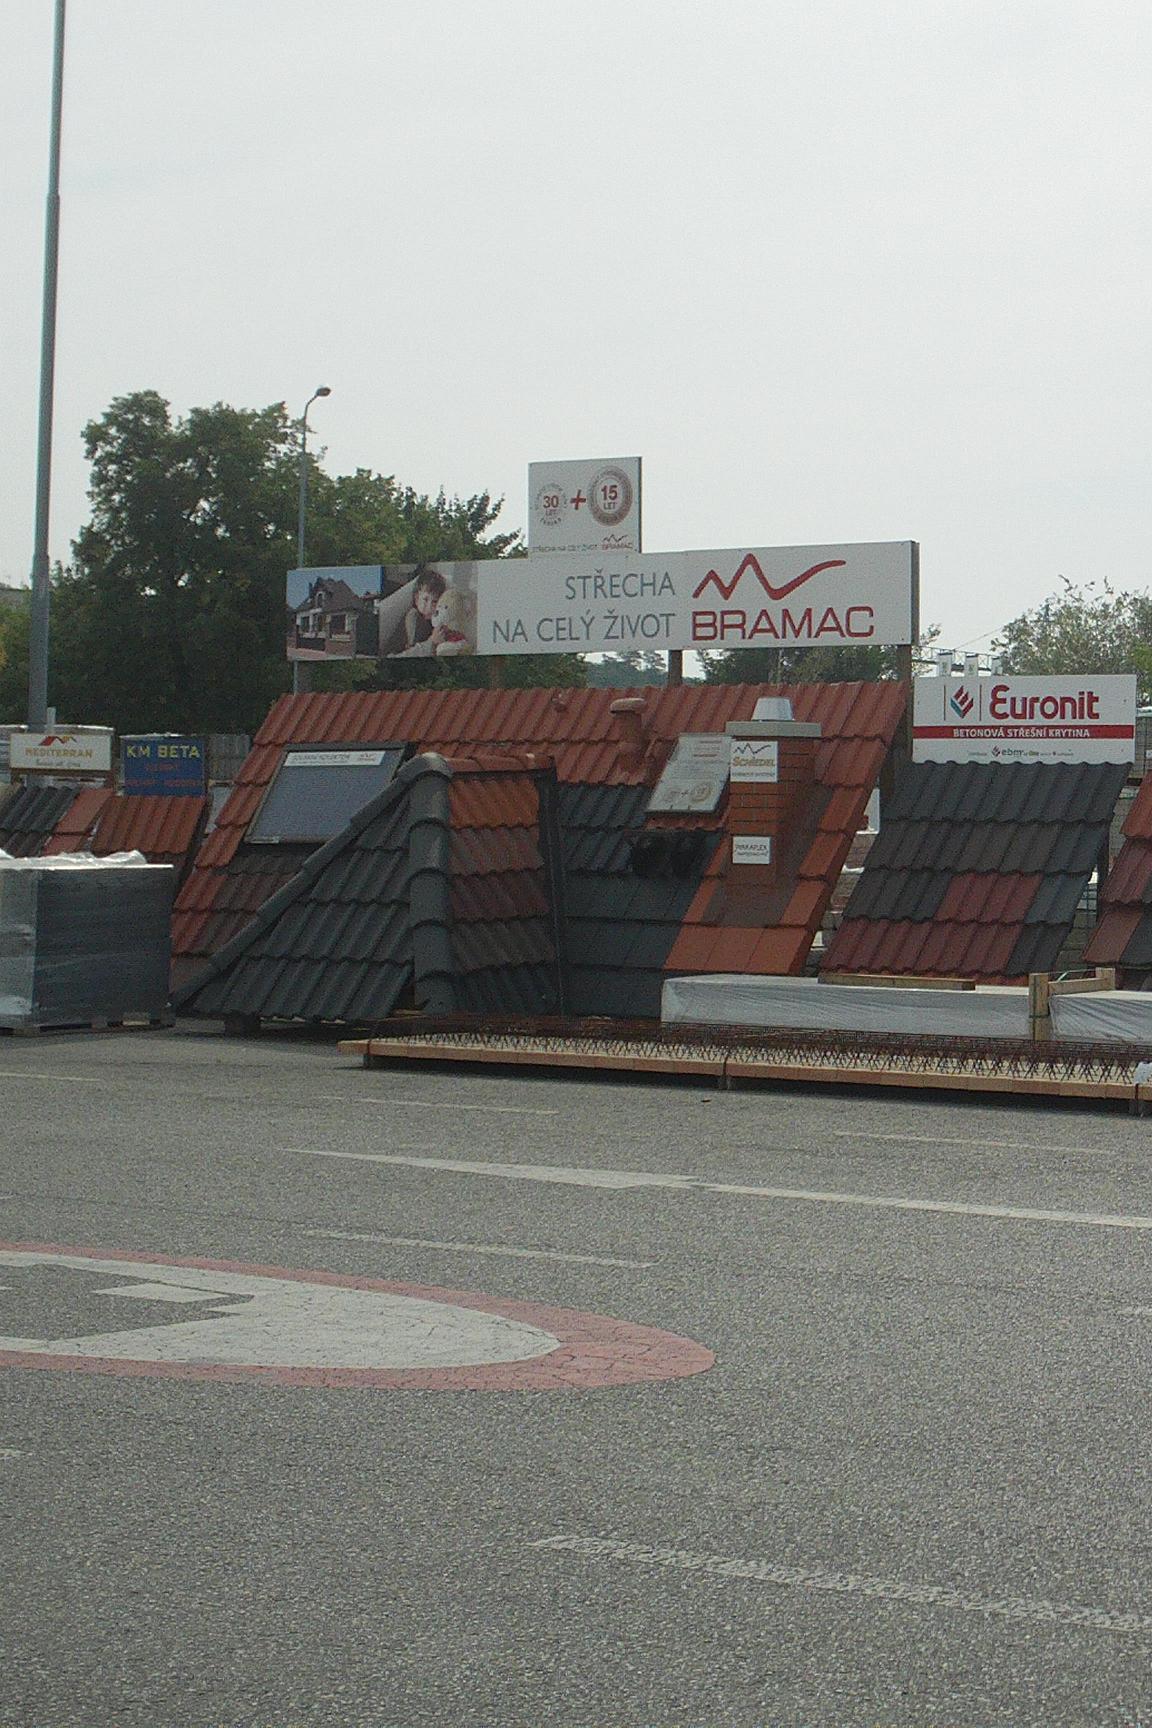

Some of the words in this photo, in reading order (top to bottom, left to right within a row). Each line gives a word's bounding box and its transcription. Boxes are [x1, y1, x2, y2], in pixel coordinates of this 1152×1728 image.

[601, 484, 618, 501] 15
[543, 495, 559, 508] 30
[603, 502, 616, 510] LET
[565, 568, 675, 599] STŘECHA
[493, 619, 528, 643] NA
[536, 609, 595, 642] CELÝ
[603, 608, 675, 640] ŽIVOT
[692, 606, 874, 641] BRAMAC
[989, 684, 1100, 720] Euronit
[953, 726, 1003, 738] BETONOVÁ
[1007, 727, 1047, 738] STŘEŠNÍ
[1049, 727, 1090, 738] KRYTINA
[126, 744, 150, 758] KM
[157, 745, 200, 758] BETA
